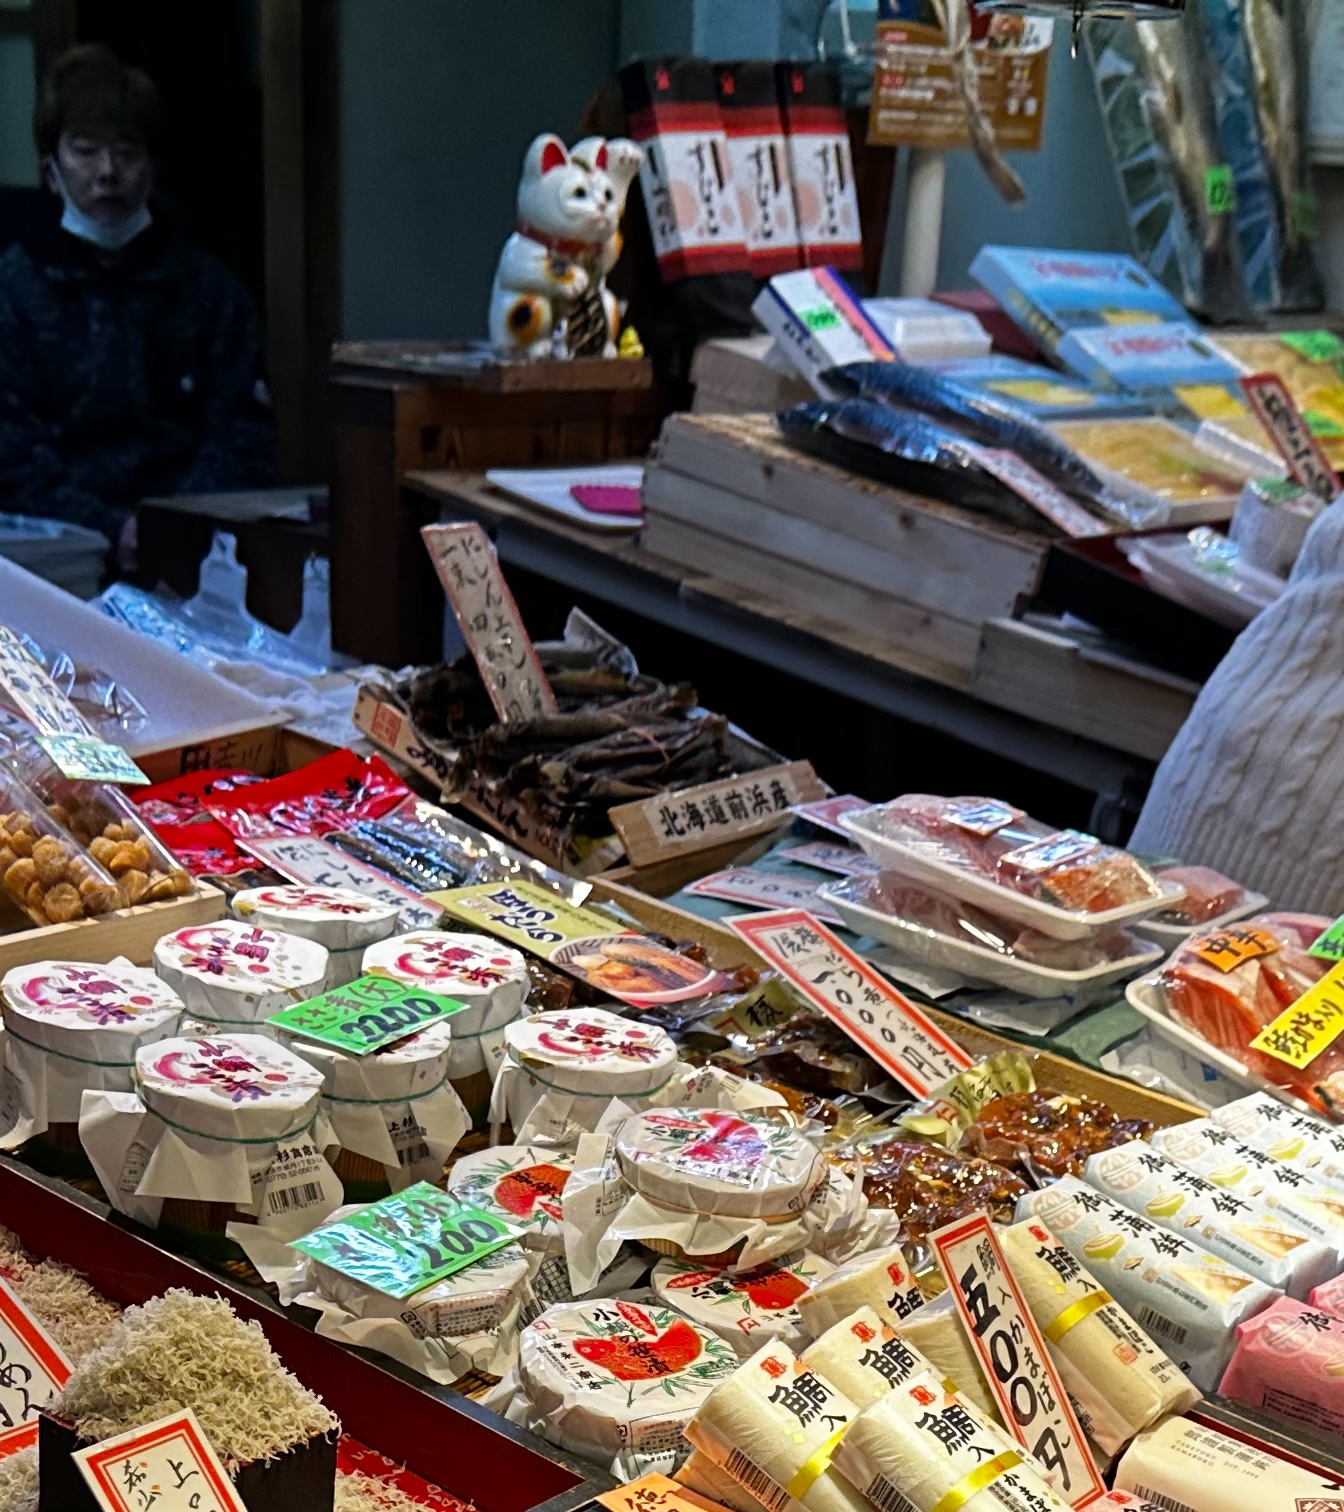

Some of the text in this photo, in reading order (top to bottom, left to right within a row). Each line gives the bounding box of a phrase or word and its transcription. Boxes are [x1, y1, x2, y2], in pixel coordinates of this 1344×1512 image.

[658, 780, 790, 839] 北海道前浜産
[1139, 1152, 1255, 1216] 御蒲鉾
[1072, 1189, 1196, 1257] 御蒲鉾
